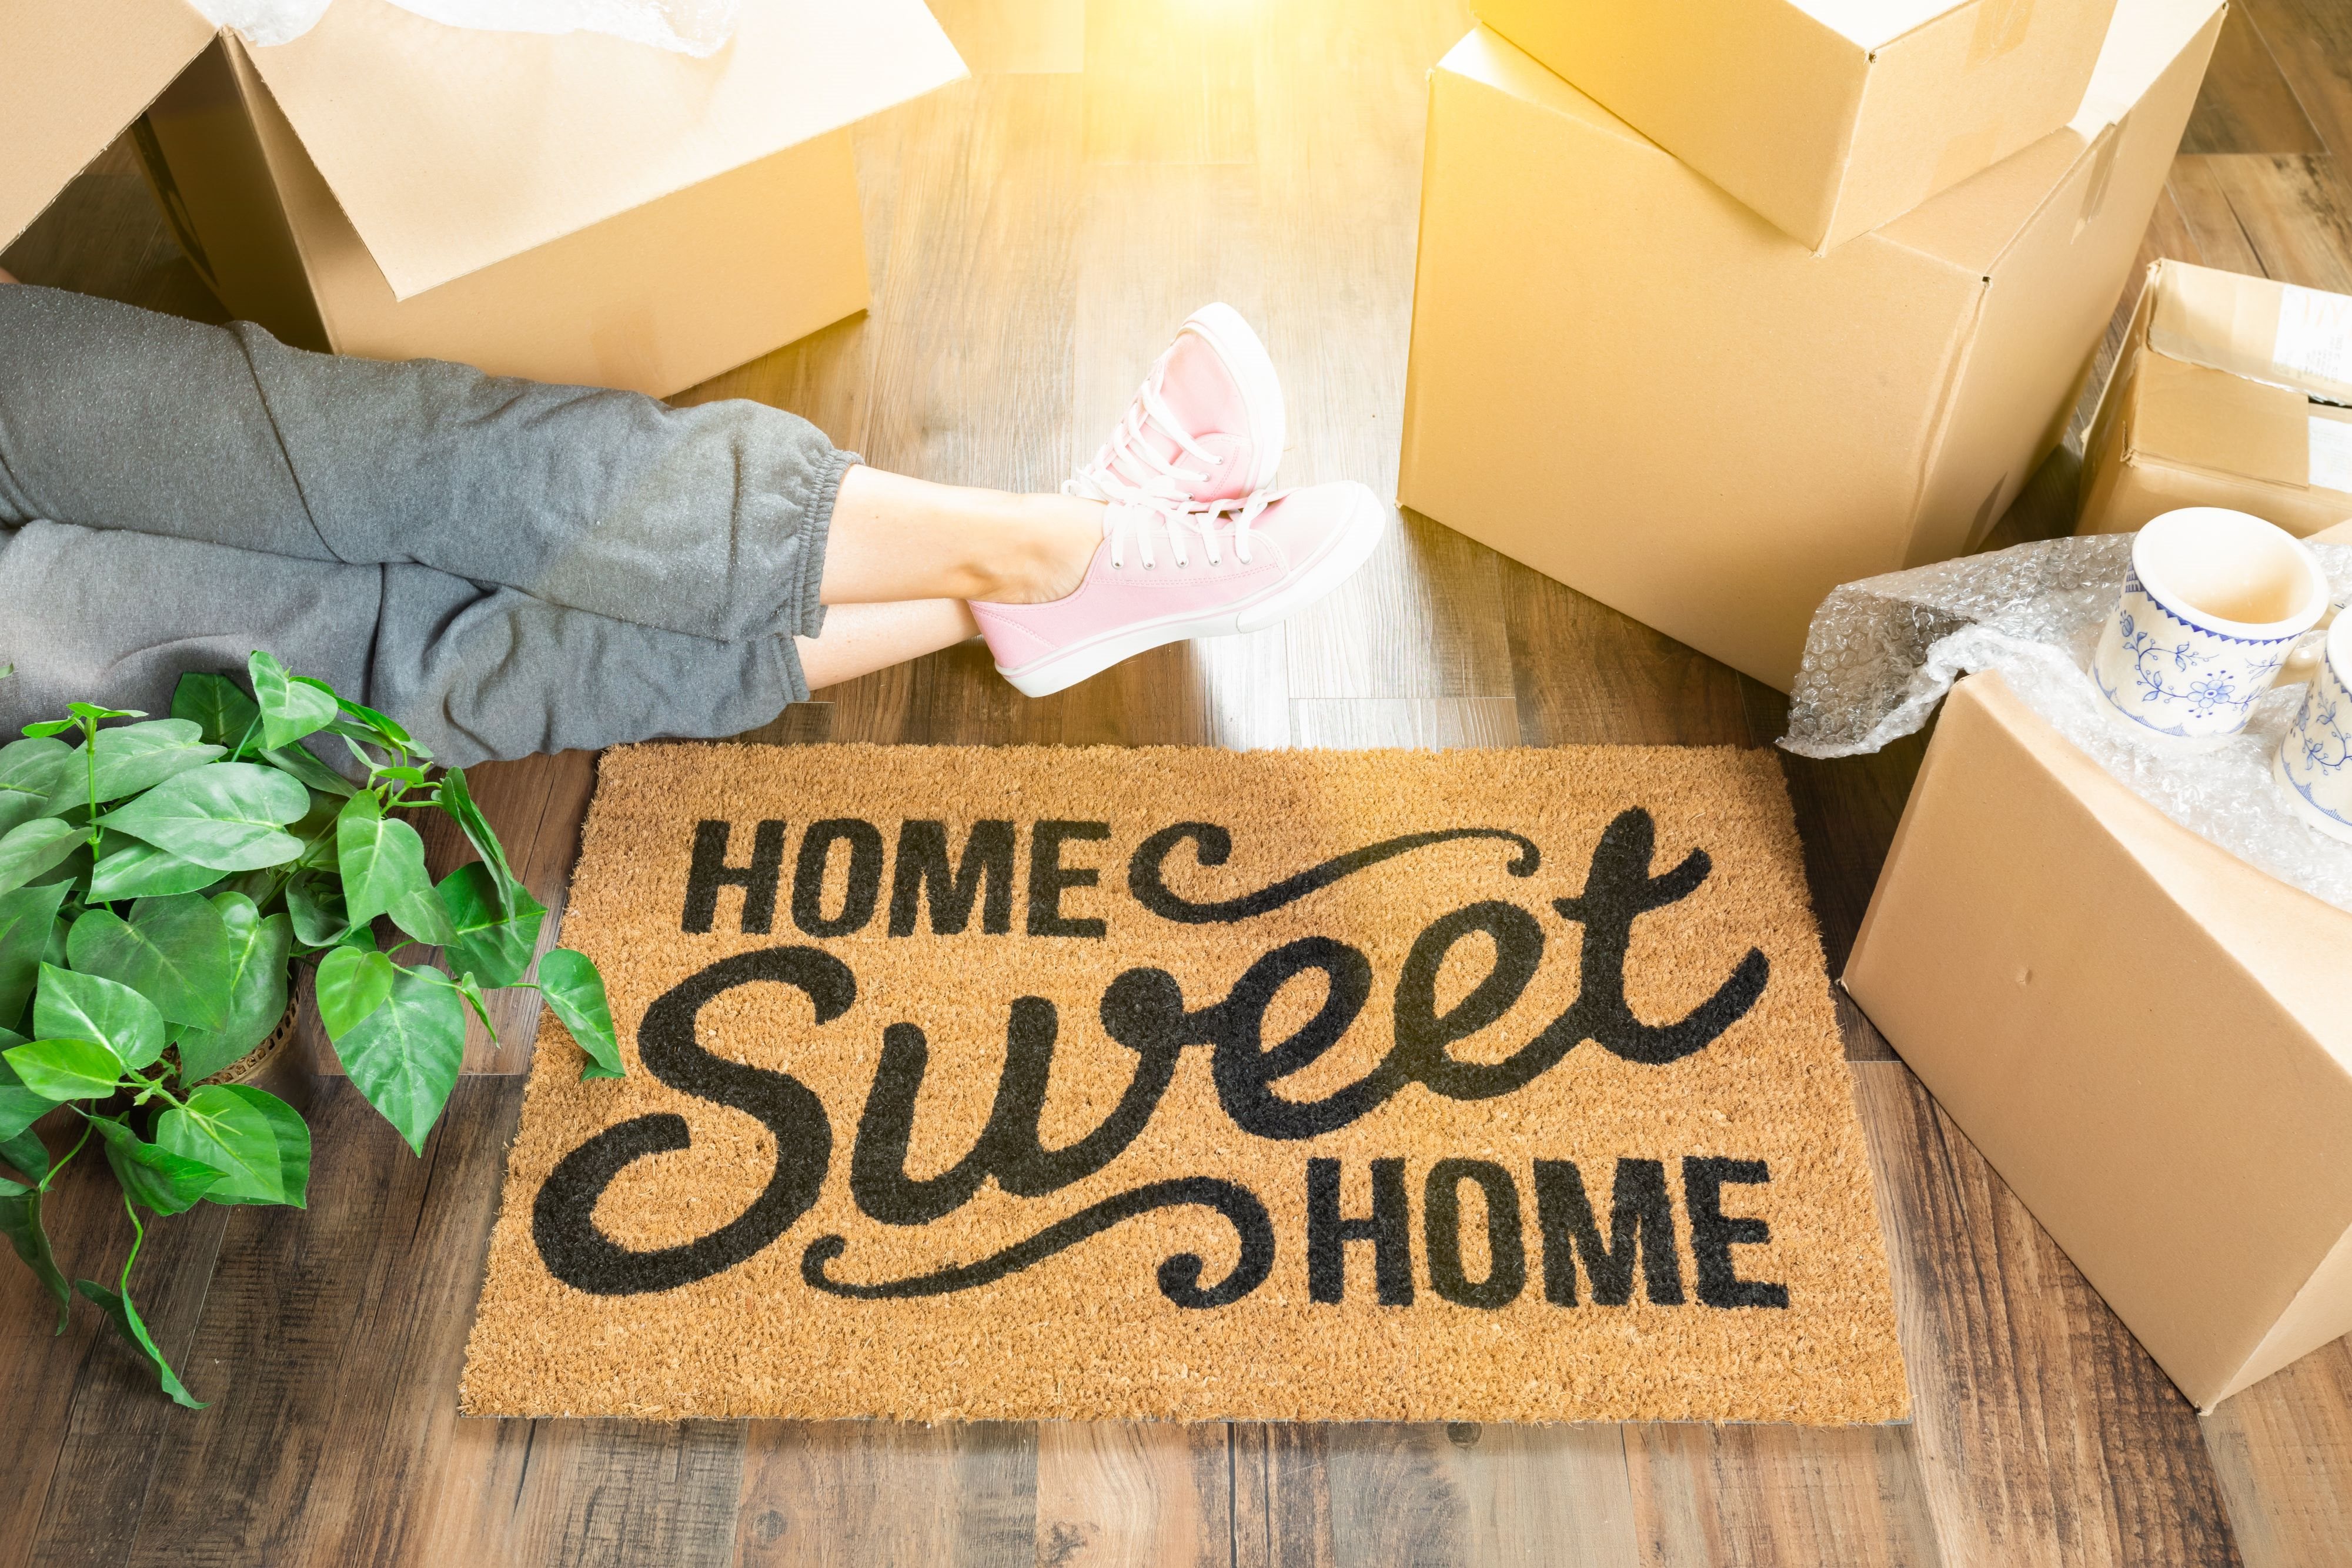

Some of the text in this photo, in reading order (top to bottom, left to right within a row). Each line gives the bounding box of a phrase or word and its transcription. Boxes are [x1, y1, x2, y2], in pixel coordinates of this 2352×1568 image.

[682, 817, 1111, 938] HOME
[532, 805, 1770, 1297] Sweet
[1307, 1156, 1789, 1310] HOME
